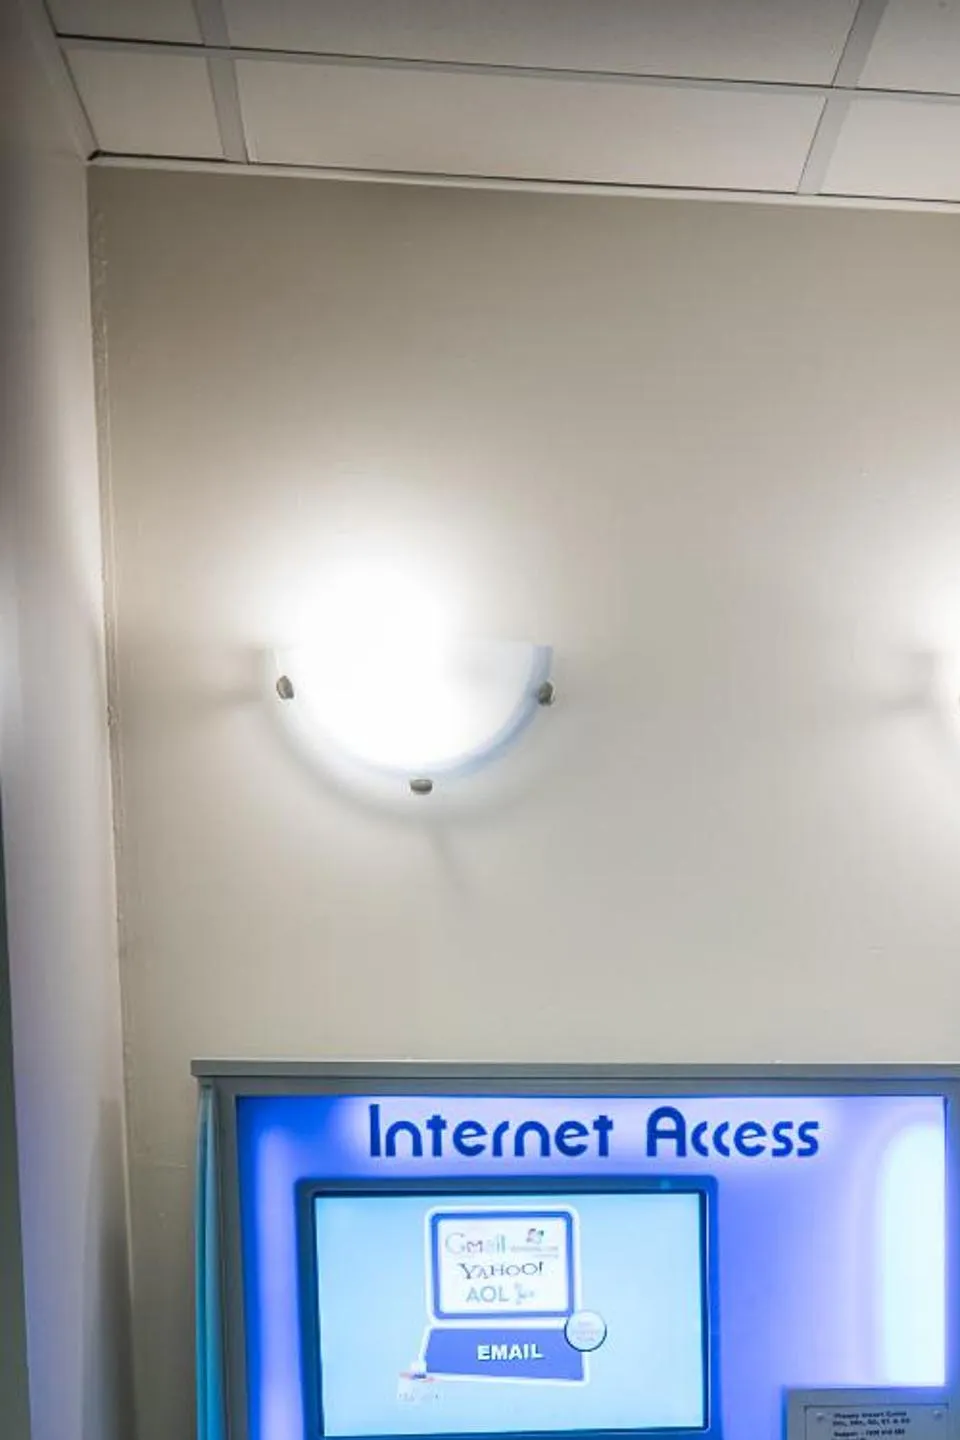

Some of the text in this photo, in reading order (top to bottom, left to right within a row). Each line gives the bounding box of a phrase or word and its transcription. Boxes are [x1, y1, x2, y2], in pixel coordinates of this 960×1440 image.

[369, 1103, 820, 1158] Internet Access
[445, 1232, 506, 1256] Gmail
[465, 1285, 510, 1303] AOL
[476, 1343, 544, 1361] EMAIL
